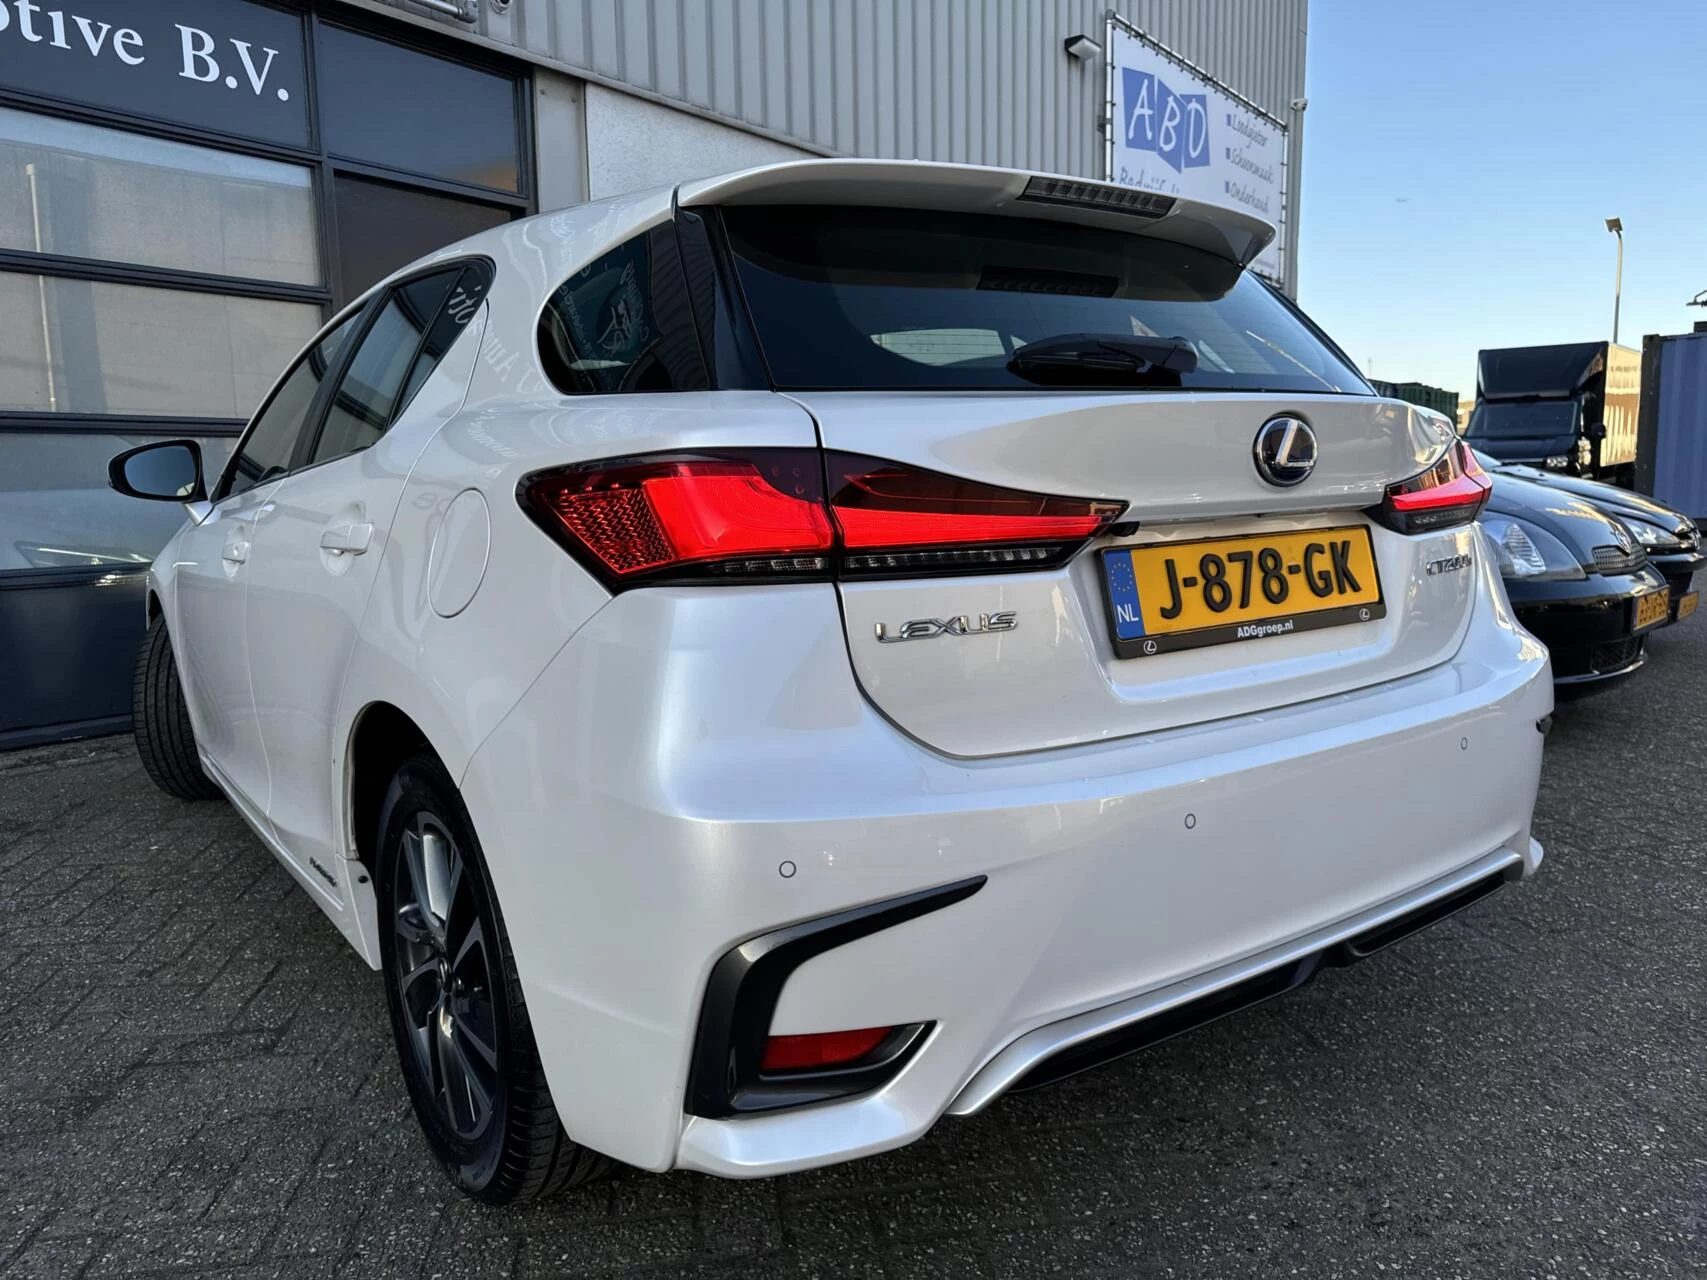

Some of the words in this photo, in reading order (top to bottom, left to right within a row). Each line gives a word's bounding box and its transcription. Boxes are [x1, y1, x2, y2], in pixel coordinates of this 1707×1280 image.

[174, 23, 289, 101] B.V.
[1127, 78, 1207, 158] ABD
[1160, 540, 1362, 620] J-878-GK
[875, 611, 1018, 643] LEXUS
[1117, 604, 1139, 623] NL
[1237, 619, 1294, 638] ADGgroep.nl
